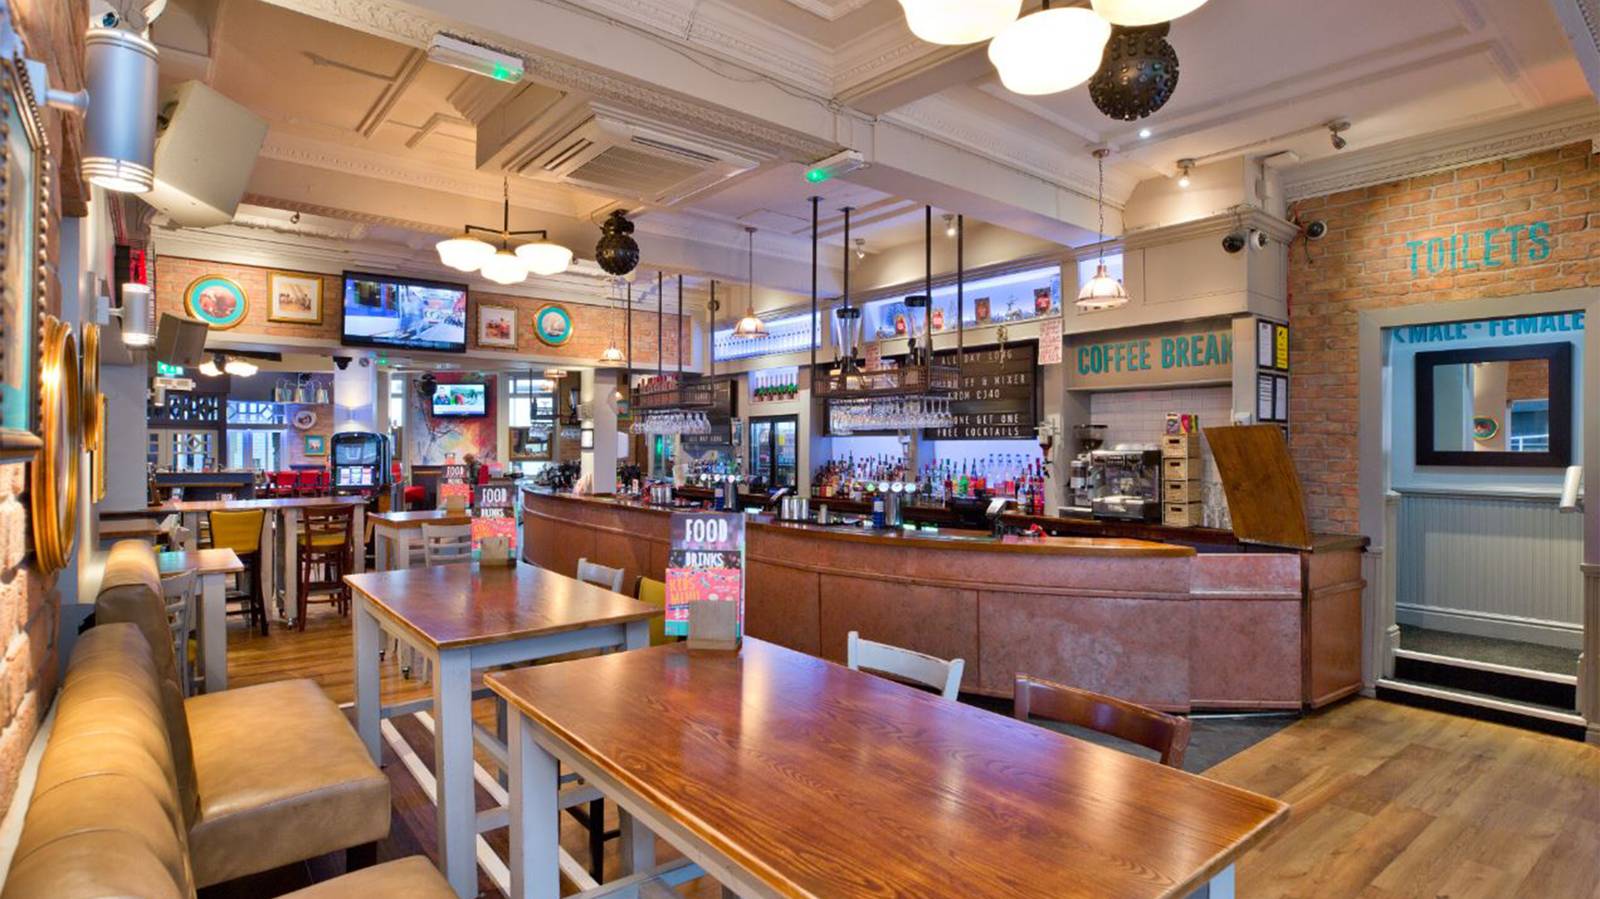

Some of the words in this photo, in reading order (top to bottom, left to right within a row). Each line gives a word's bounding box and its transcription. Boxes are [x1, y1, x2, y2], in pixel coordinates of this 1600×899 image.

[1407, 221, 1552, 279] TOILETS
[1408, 324, 1467, 344] MALE
[1489, 312, 1585, 338] FEMALE
[1077, 340, 1152, 376] COFFEE
[1001, 413, 1019, 424] ONE
[965, 426, 1019, 437] COCKTAILS
[482, 488, 507, 503] FOOD
[685, 518, 728, 543] FOOD
[685, 551, 725, 567] DRINKS
